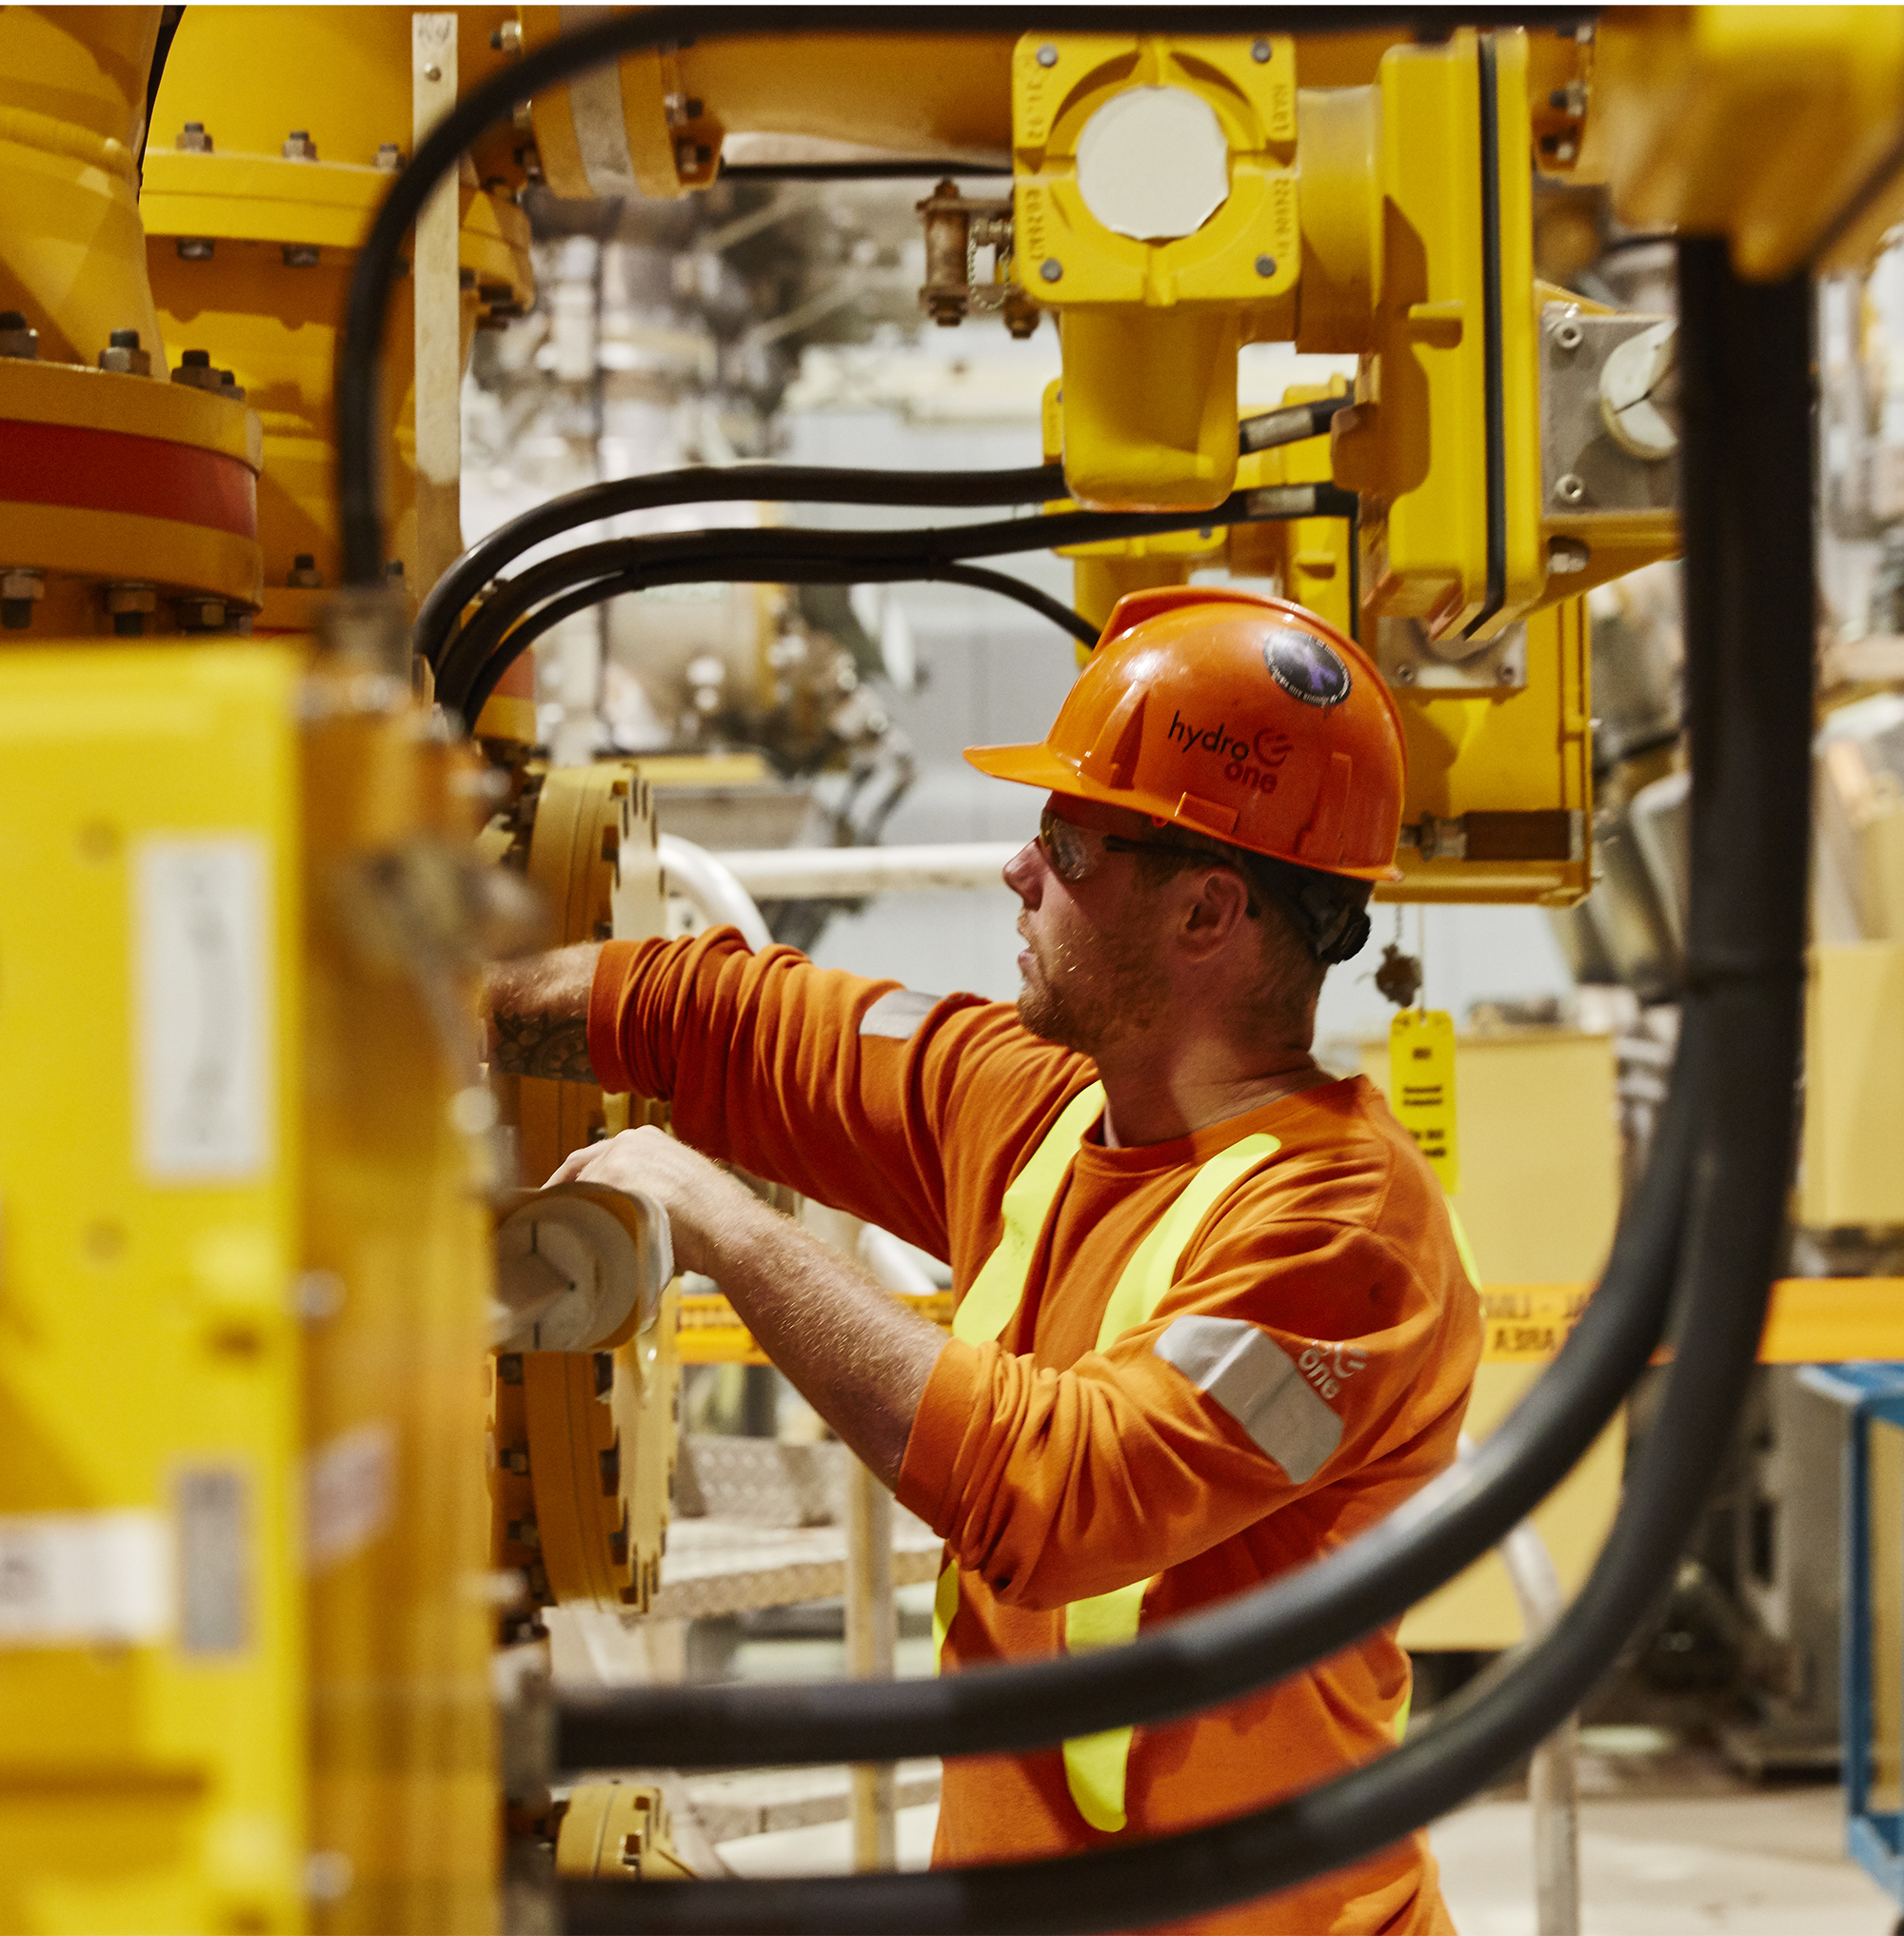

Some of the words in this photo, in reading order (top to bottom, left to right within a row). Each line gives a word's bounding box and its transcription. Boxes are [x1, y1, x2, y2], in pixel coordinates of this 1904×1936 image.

[1168, 709, 1249, 761] hydro
[1224, 761, 1278, 794] one
[1298, 1348, 1340, 1400] one
